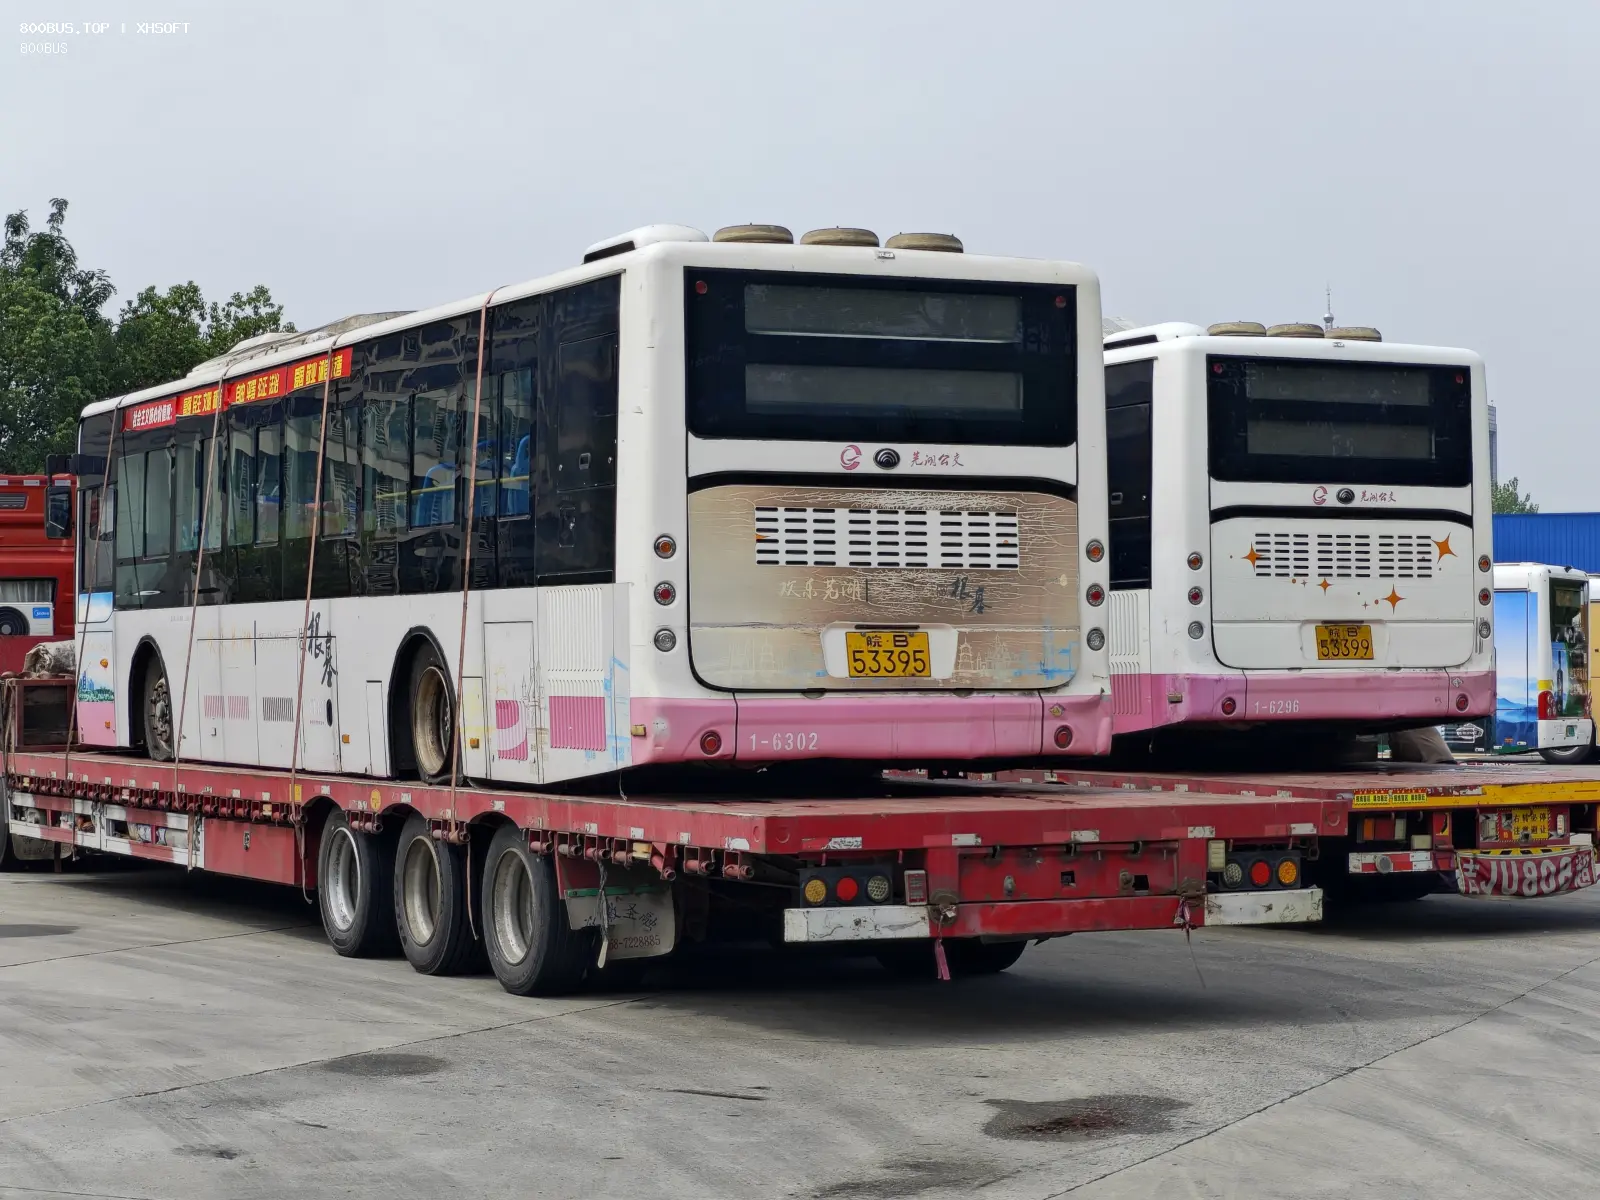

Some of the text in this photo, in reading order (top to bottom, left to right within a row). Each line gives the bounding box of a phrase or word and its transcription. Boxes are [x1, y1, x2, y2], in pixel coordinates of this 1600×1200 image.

[911, 450, 964, 467] 芜湖公交
[1320, 638, 1370, 657] 53399
[852, 649, 926, 674] 53395
[1254, 699, 1299, 715] 1-6296
[749, 732, 818, 751] 1-6302
